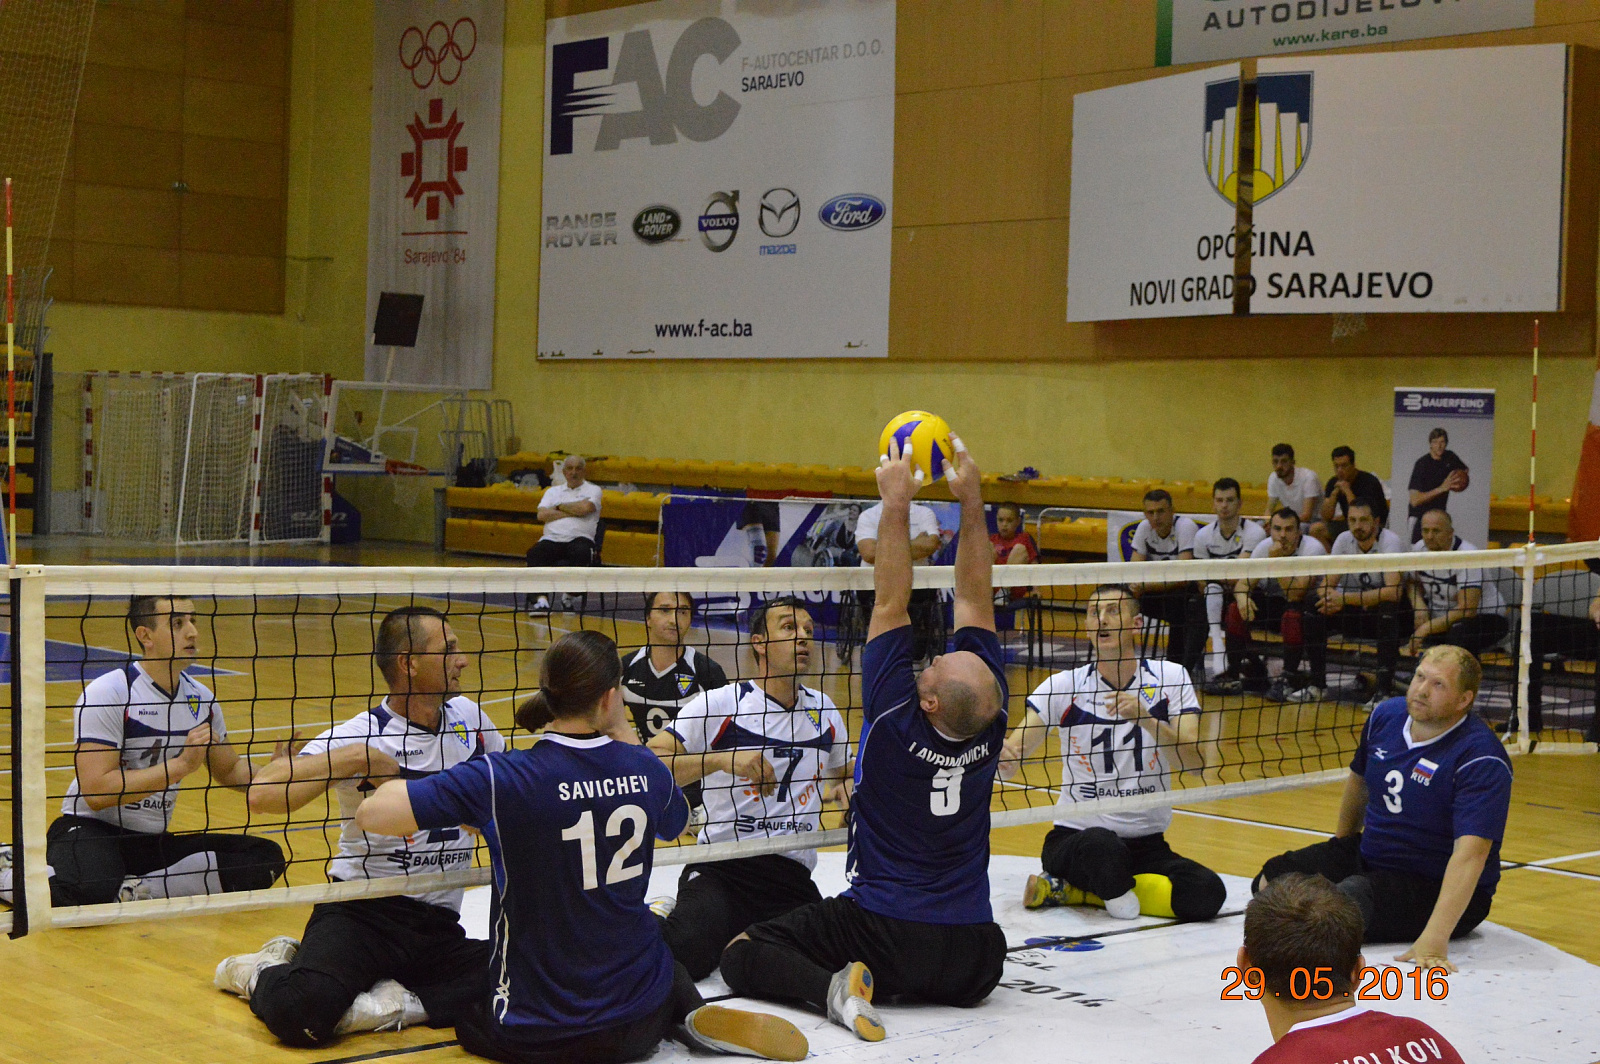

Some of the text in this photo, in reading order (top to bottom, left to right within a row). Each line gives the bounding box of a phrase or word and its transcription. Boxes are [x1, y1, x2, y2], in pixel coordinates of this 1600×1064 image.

[1203, 0, 1461, 31] AUTODIJEL
[1273, 24, 1388, 46] www.kare.ba
[742, 39, 884, 71] F-AUTOCENTAR D.O.O.
[550, 16, 742, 155] FAC
[741, 71, 804, 92] SARAJEVO
[546, 212, 617, 230] RANGE
[641, 213, 666, 223] LAND
[701, 217, 737, 227] VOLVO
[829, 199, 873, 225] Ford
[546, 230, 617, 248] ROVER
[643, 223, 674, 236] ROVER
[404, 248, 449, 267] Sarajevo
[1130, 279, 1175, 306] NOVI
[1267, 272, 1433, 299] SARAJEVO
[655, 318, 753, 338] www.f-ac.ba
[1091, 724, 1144, 774] 11
[773, 748, 804, 803] 7
[1410, 771, 1430, 787] RUS
[558, 775, 649, 801] SAVICHEV
[1382, 769, 1404, 814] 3
[561, 804, 648, 890] 12
[413, 852, 474, 867] BAUERFEIN
[1334, 1037, 1442, 1064] LKOV
